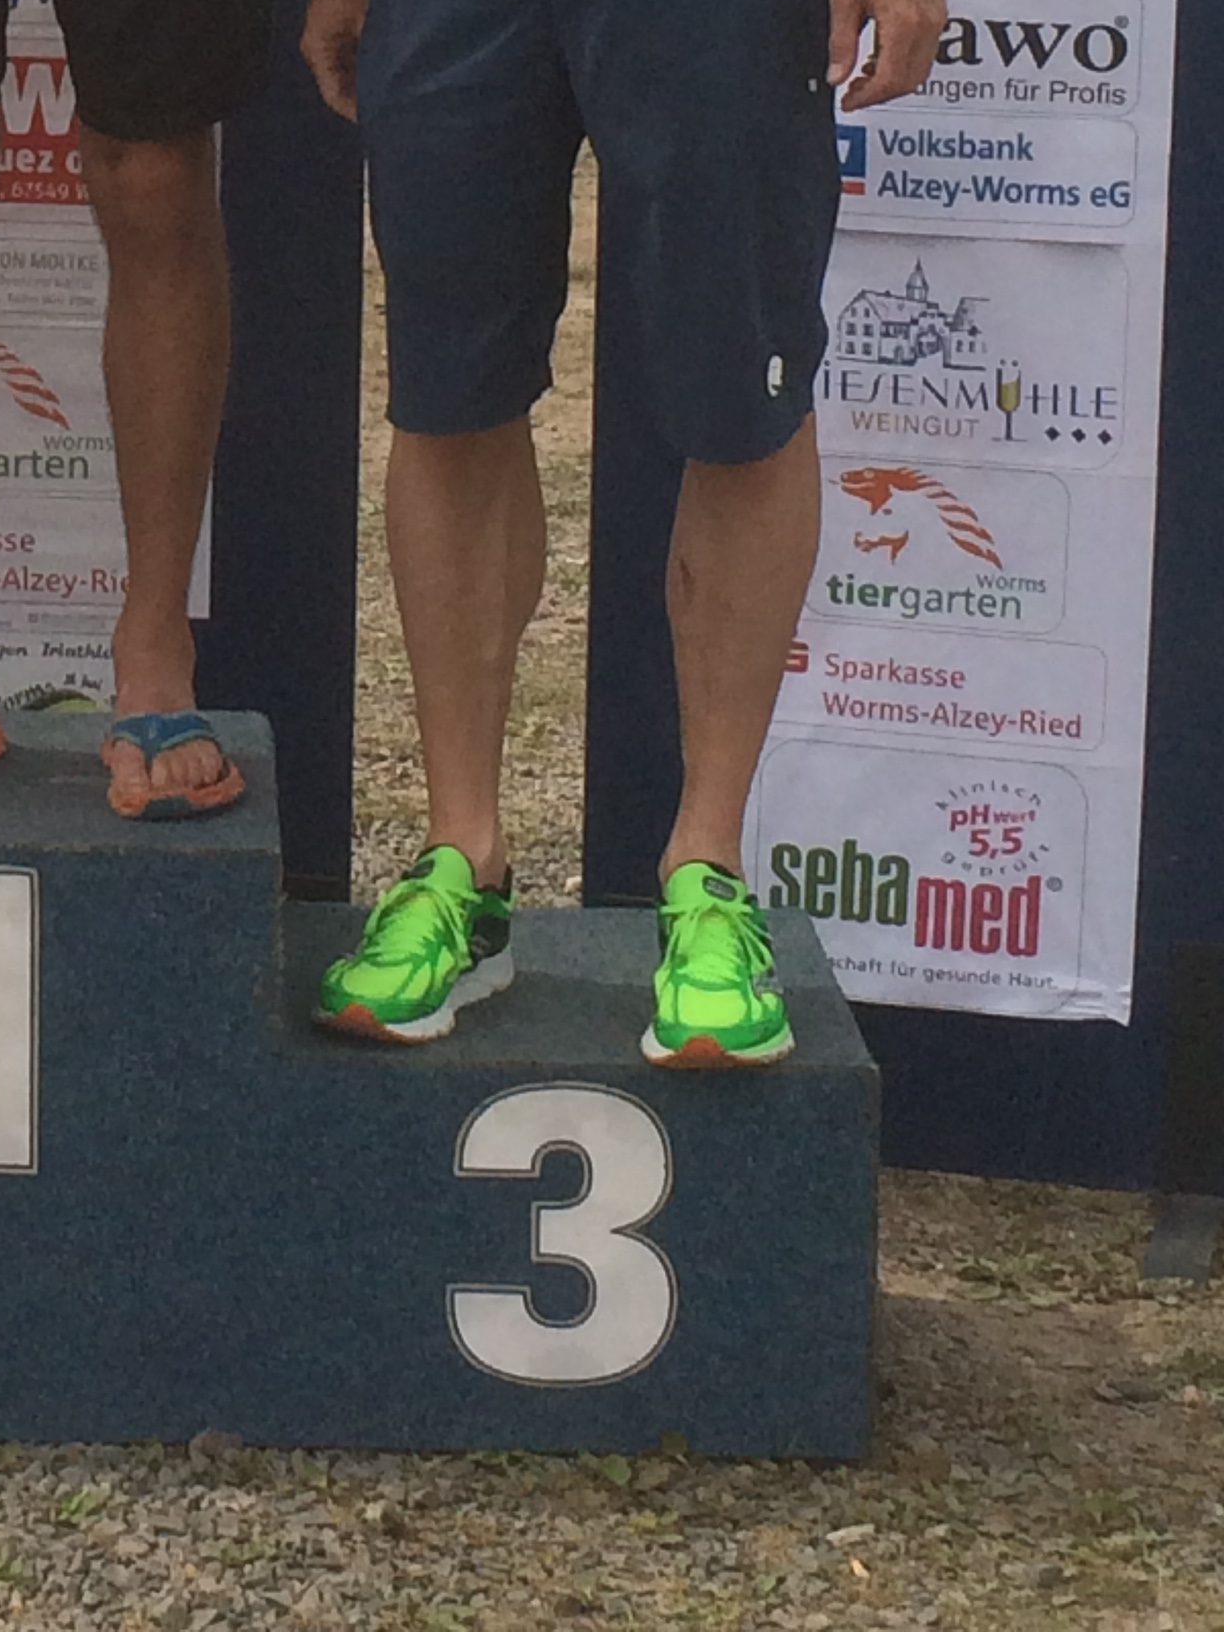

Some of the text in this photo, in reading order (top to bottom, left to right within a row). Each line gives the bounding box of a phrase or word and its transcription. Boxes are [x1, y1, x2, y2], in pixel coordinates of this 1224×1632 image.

[936, 16, 1129, 73] awo
[1005, 78, 1040, 102] für
[1048, 79, 1128, 106] Profis
[878, 129, 1035, 162] Volksbank
[877, 170, 1132, 209] Alzey-Worms eG
[852, 410, 979, 439] WEINGUT
[825, 574, 1022, 620] tiergarten
[824, 653, 966, 689] Sparkasse
[822, 691, 1082, 740] Worms-Alzey-Ried
[949, 804, 1037, 831] pH Wert
[968, 826, 1025, 860] 5,5
[890, 959, 918, 980] für
[923, 965, 1004, 987] gesunde
[446, 1082, 679, 1385] 3
